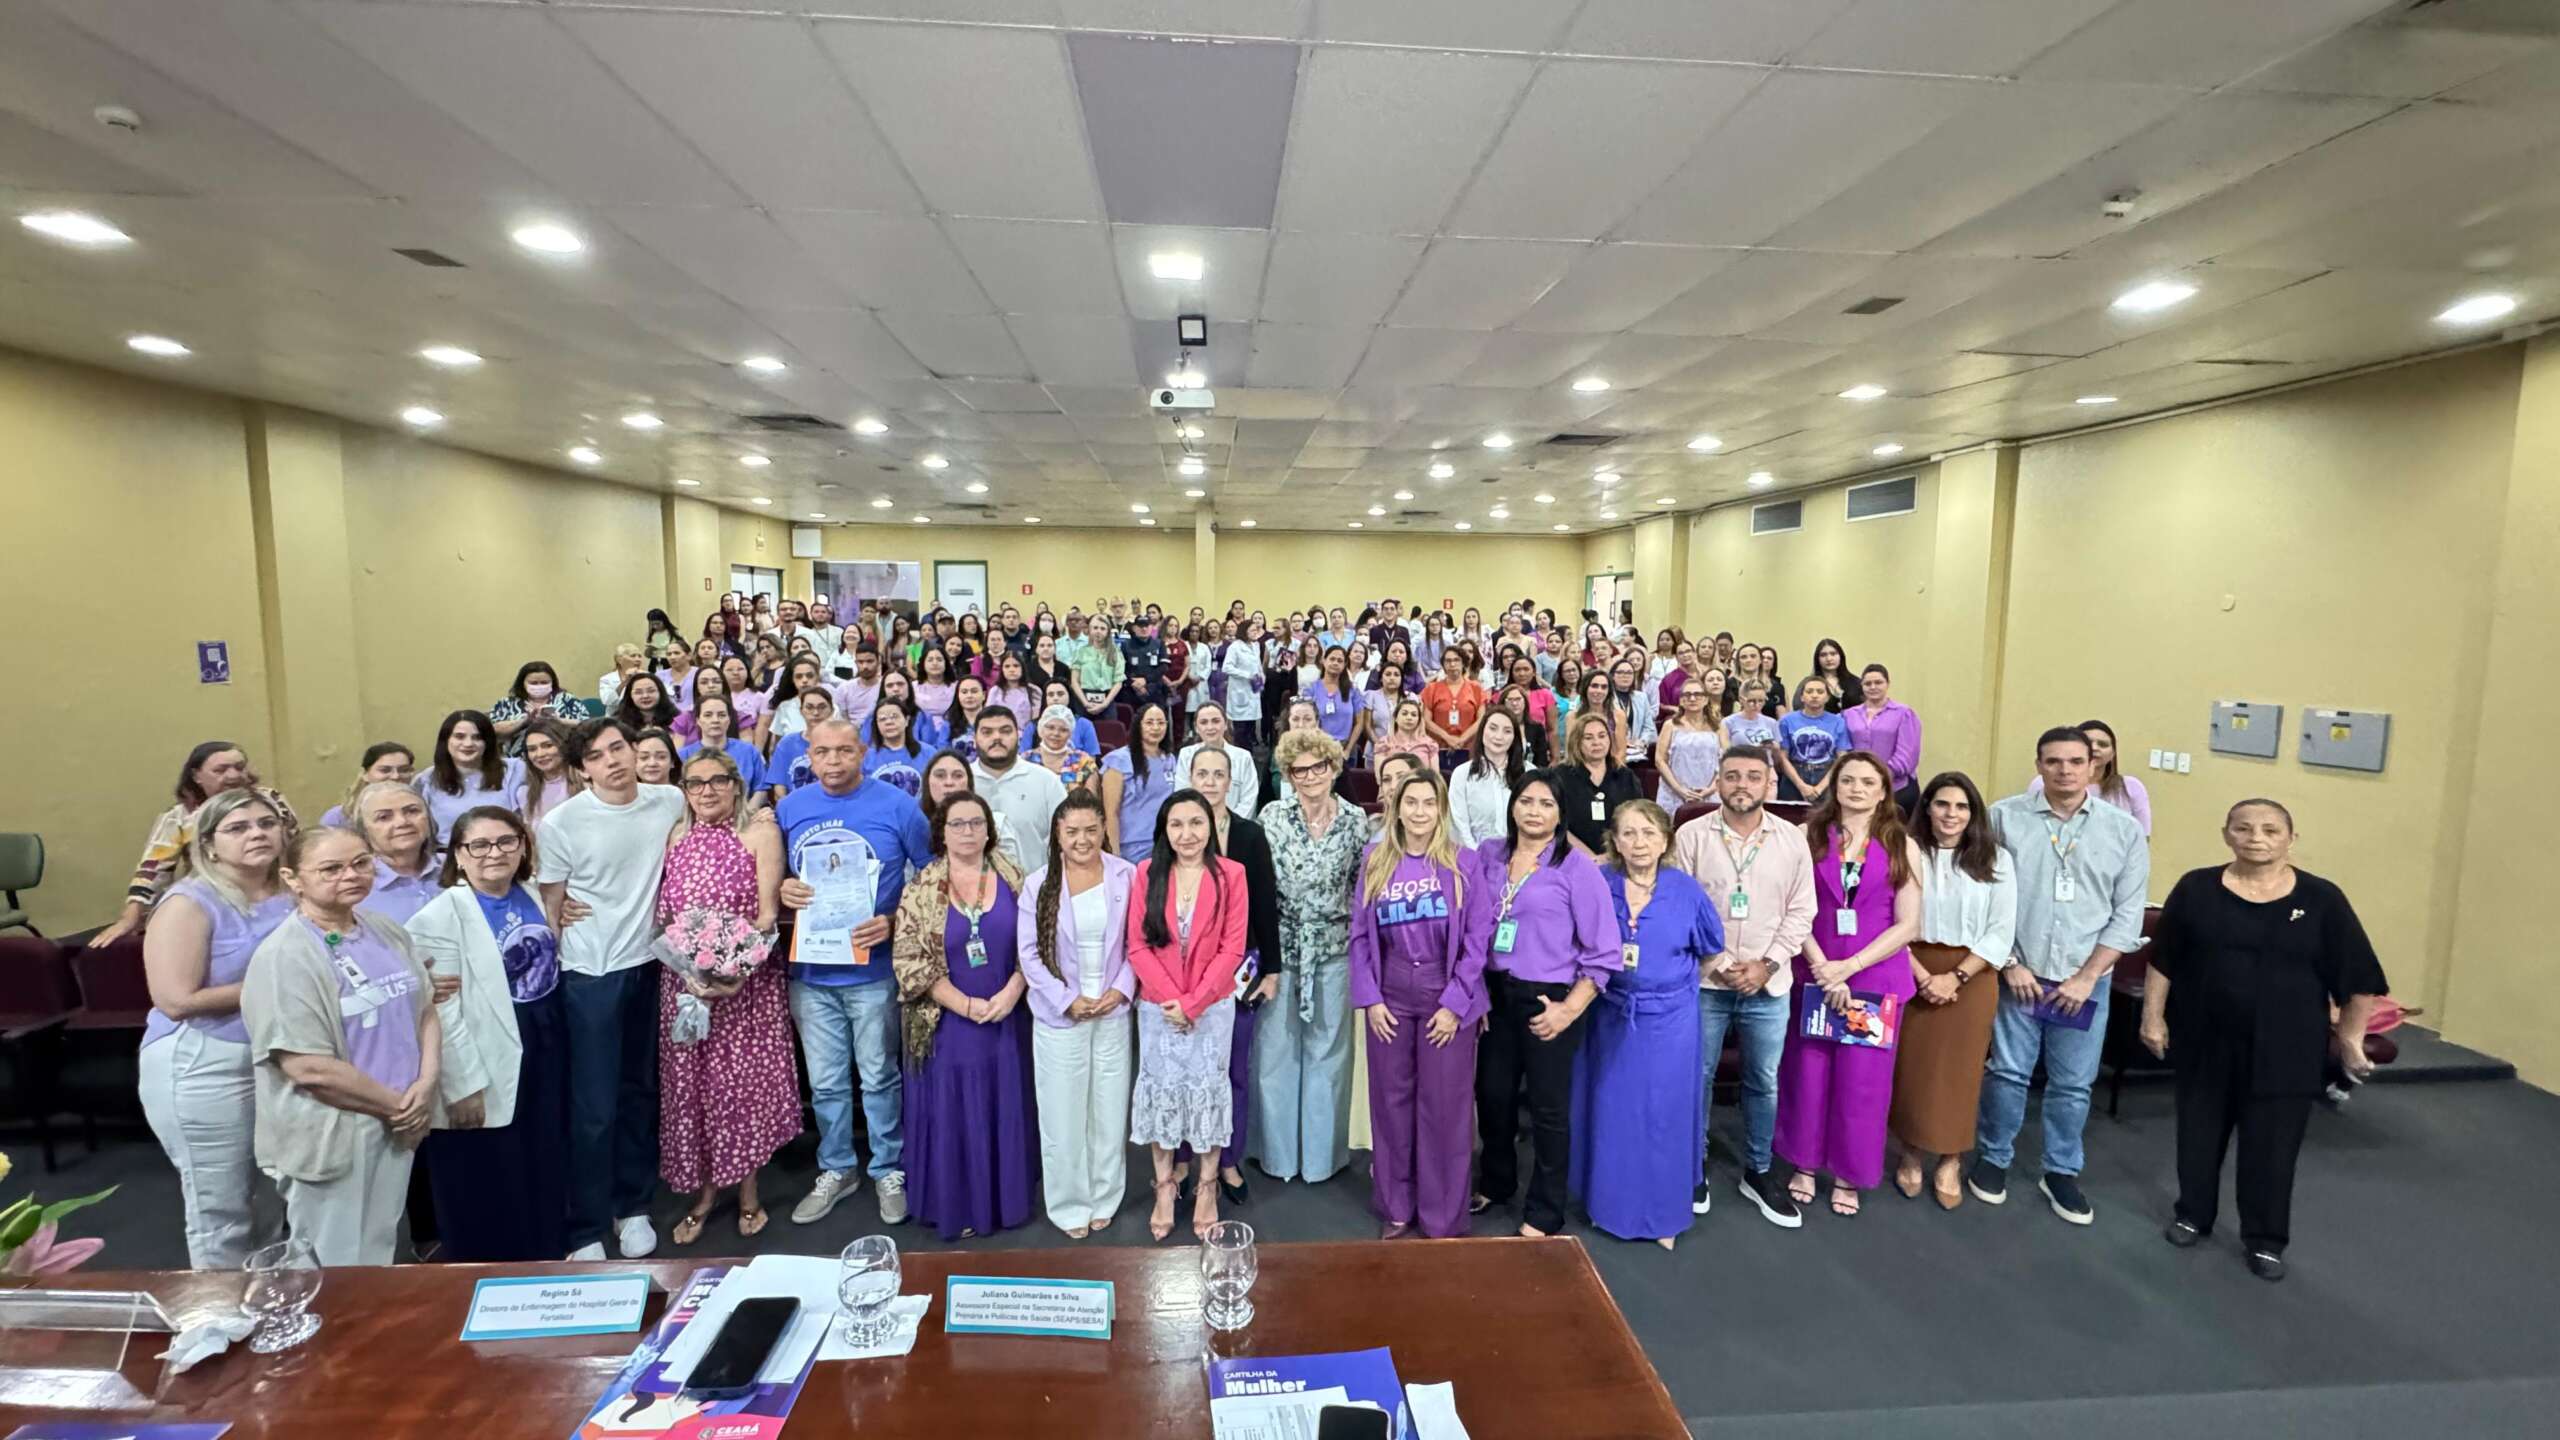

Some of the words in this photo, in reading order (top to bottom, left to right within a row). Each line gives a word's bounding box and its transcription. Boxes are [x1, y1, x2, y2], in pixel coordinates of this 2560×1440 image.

[1376, 893, 1449, 926] LILÁS
[382, 980, 409, 998] US
[540, 1289, 569, 1299] Regina
[981, 1290, 1009, 1298] Juliana
[1011, 1291, 1052, 1300] Guimarães
[1061, 1293, 1080, 1301] Silva
[521, 1302, 567, 1312] Enfermagem
[579, 1299, 607, 1309] Hospital
[992, 1303, 1020, 1312] Especial
[1032, 1304, 1065, 1312] Secretaria
[1077, 1306, 1105, 1315] Atenção
[1030, 1313, 1051, 1322] Saúde
[1223, 1371, 1264, 1380] CARTILHA
[1225, 1379, 1306, 1396] Mulher
[716, 1423, 760, 1435] CEARÁ
